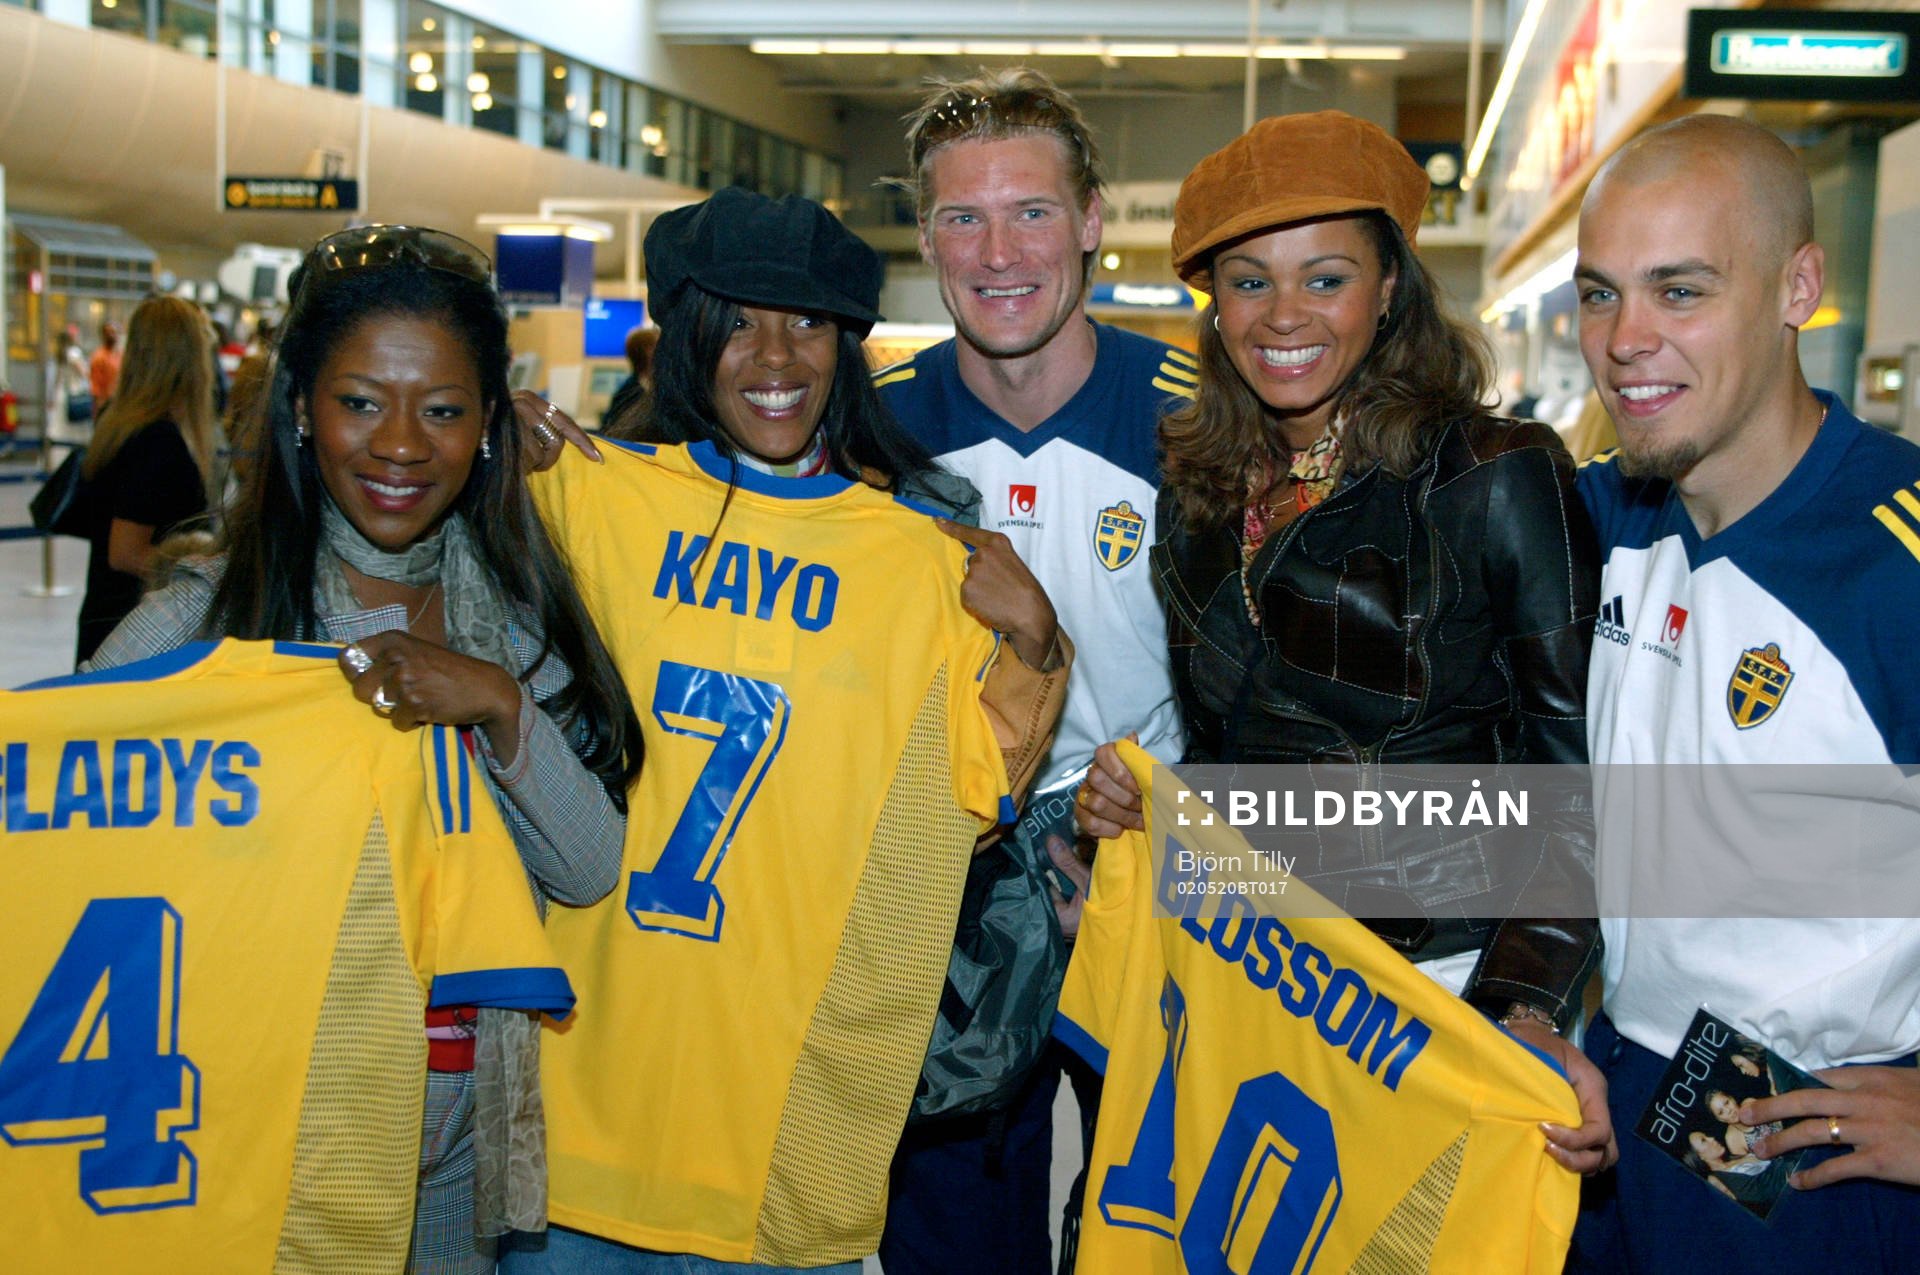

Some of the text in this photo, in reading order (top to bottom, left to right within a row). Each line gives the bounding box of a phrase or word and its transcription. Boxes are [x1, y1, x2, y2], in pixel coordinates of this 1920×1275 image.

[653, 530, 839, 632] KAYO
[0, 738, 261, 833] LADYS
[626, 660, 791, 943] 7
[0, 896, 202, 1215] 4
[1158, 833, 1432, 1092] BLOSSOM
[1650, 1022, 1729, 1144] afro-dite
[1098, 970, 1343, 1275] 10
